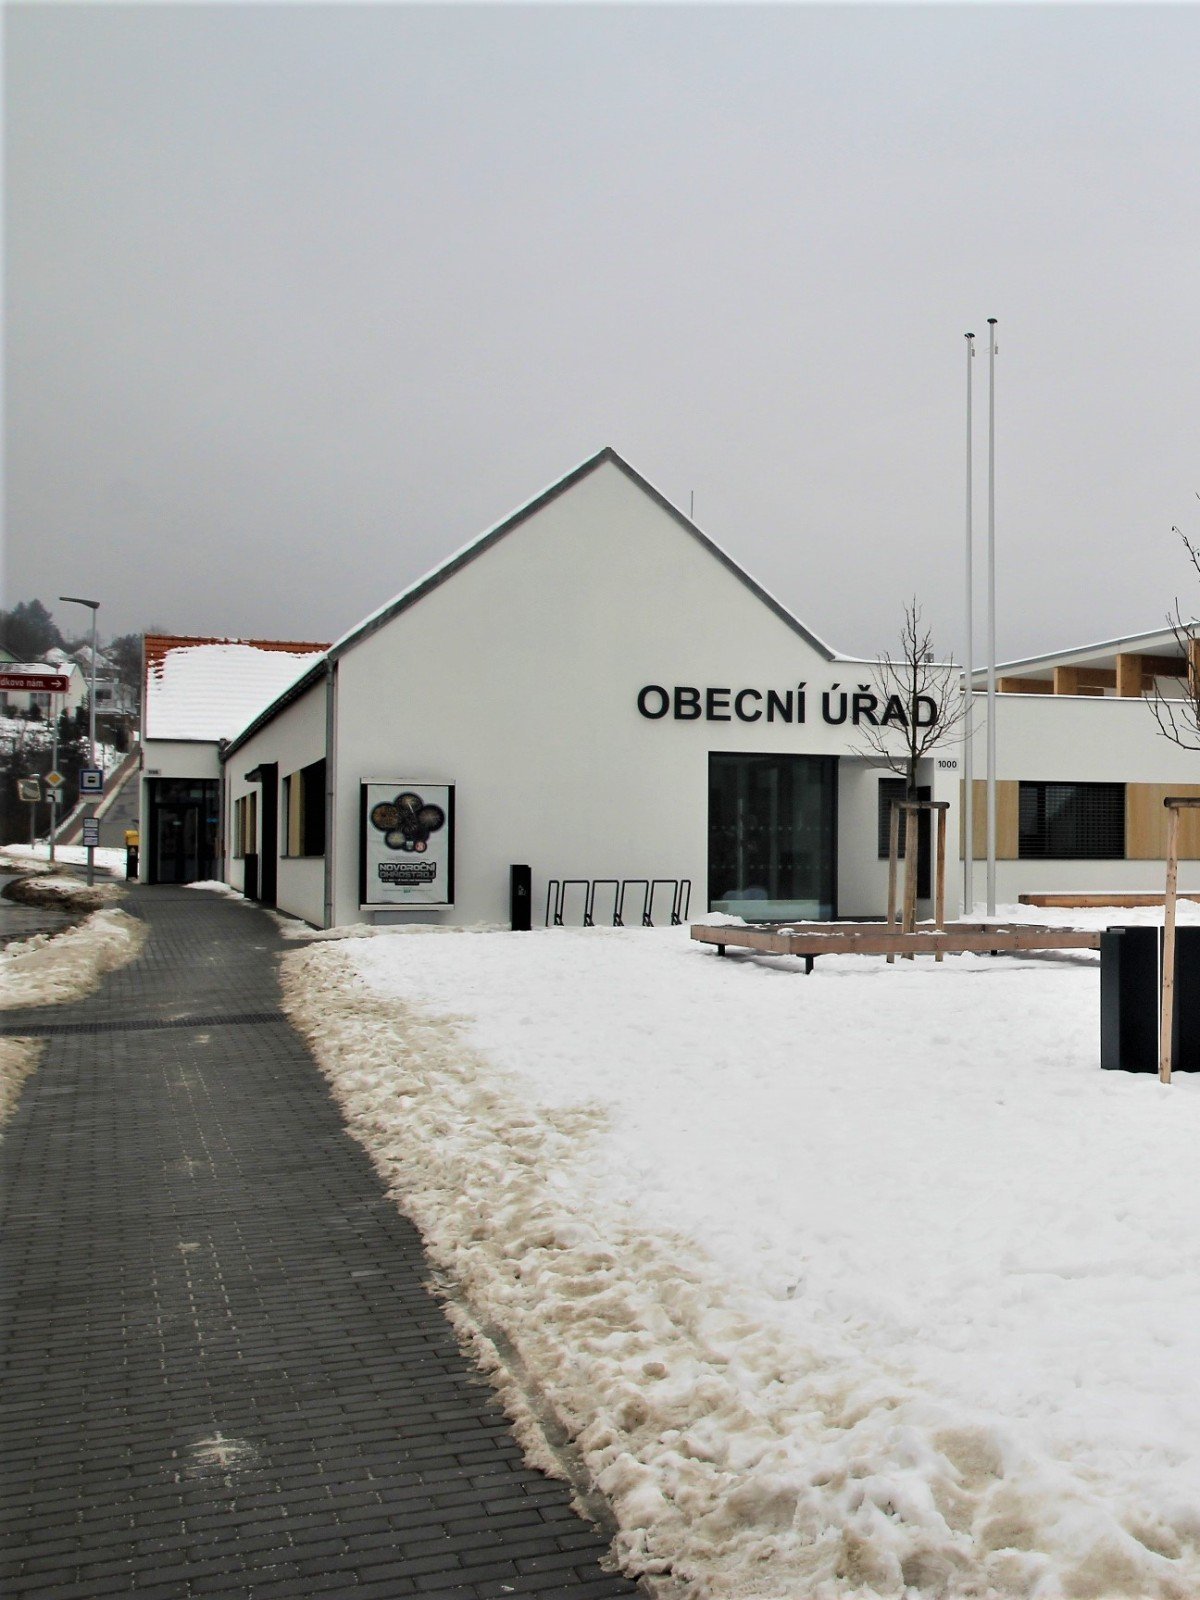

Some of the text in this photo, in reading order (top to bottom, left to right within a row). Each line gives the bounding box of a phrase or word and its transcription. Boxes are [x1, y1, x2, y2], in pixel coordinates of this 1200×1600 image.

[638, 681, 939, 728] OBECNÍ ÚŘAD
[938, 760, 957, 768] 1000
[379, 862, 435, 871] NOVOROČNÍ
